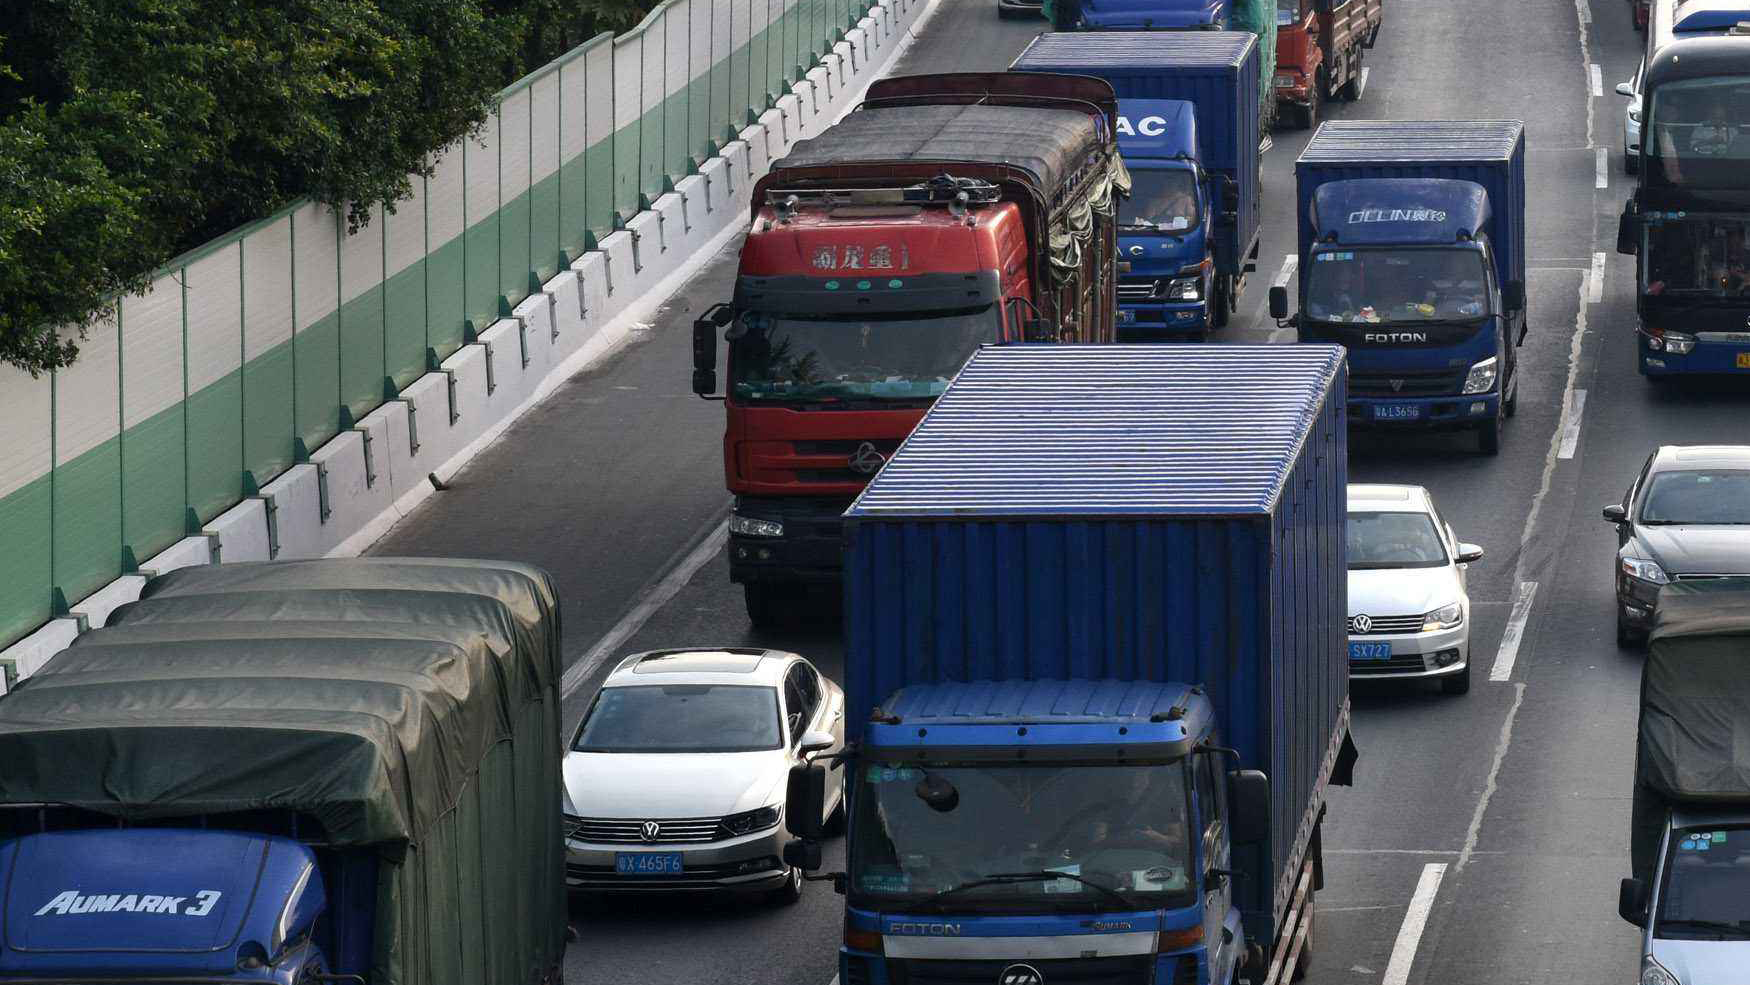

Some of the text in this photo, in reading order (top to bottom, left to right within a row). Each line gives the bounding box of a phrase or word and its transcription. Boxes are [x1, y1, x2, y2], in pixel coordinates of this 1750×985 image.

[1365, 333, 1426, 343] FOTON
[34, 890, 222, 916] AUMARK 3
[890, 923, 961, 935] FOTON
